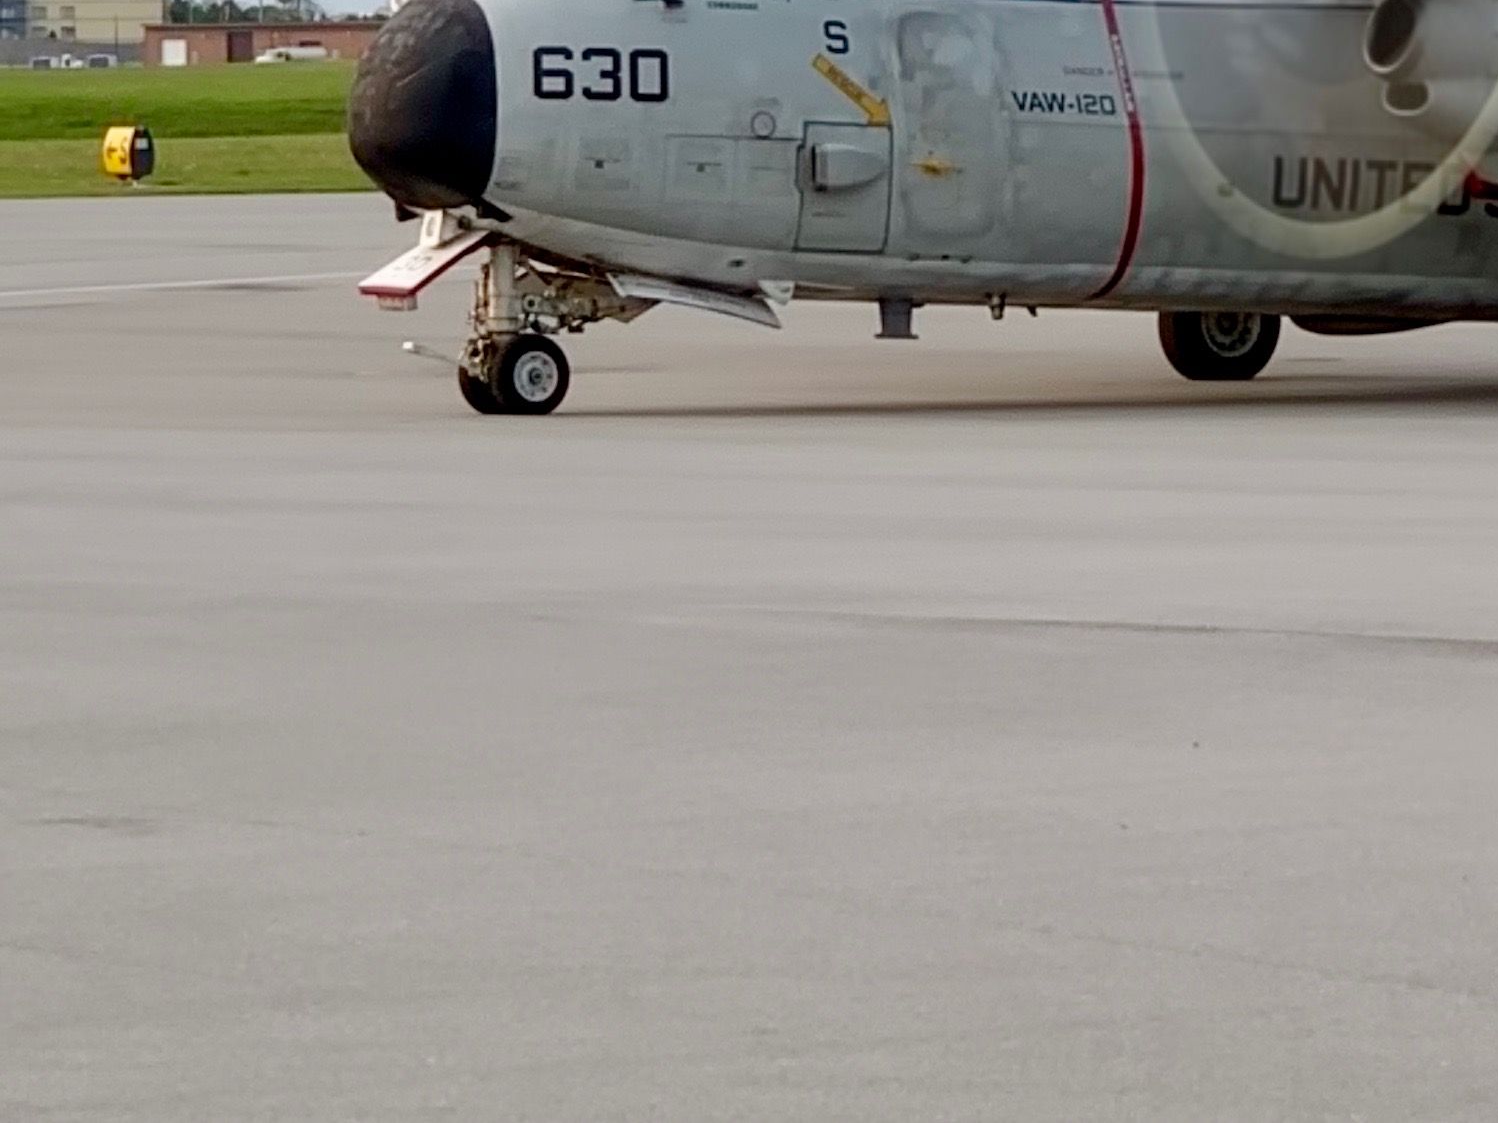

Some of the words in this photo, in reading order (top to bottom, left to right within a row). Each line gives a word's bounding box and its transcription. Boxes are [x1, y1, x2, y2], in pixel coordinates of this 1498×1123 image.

[823, 20, 849, 54] S
[533, 46, 669, 102] 630
[1011, 90, 1117, 116] VAW-120
